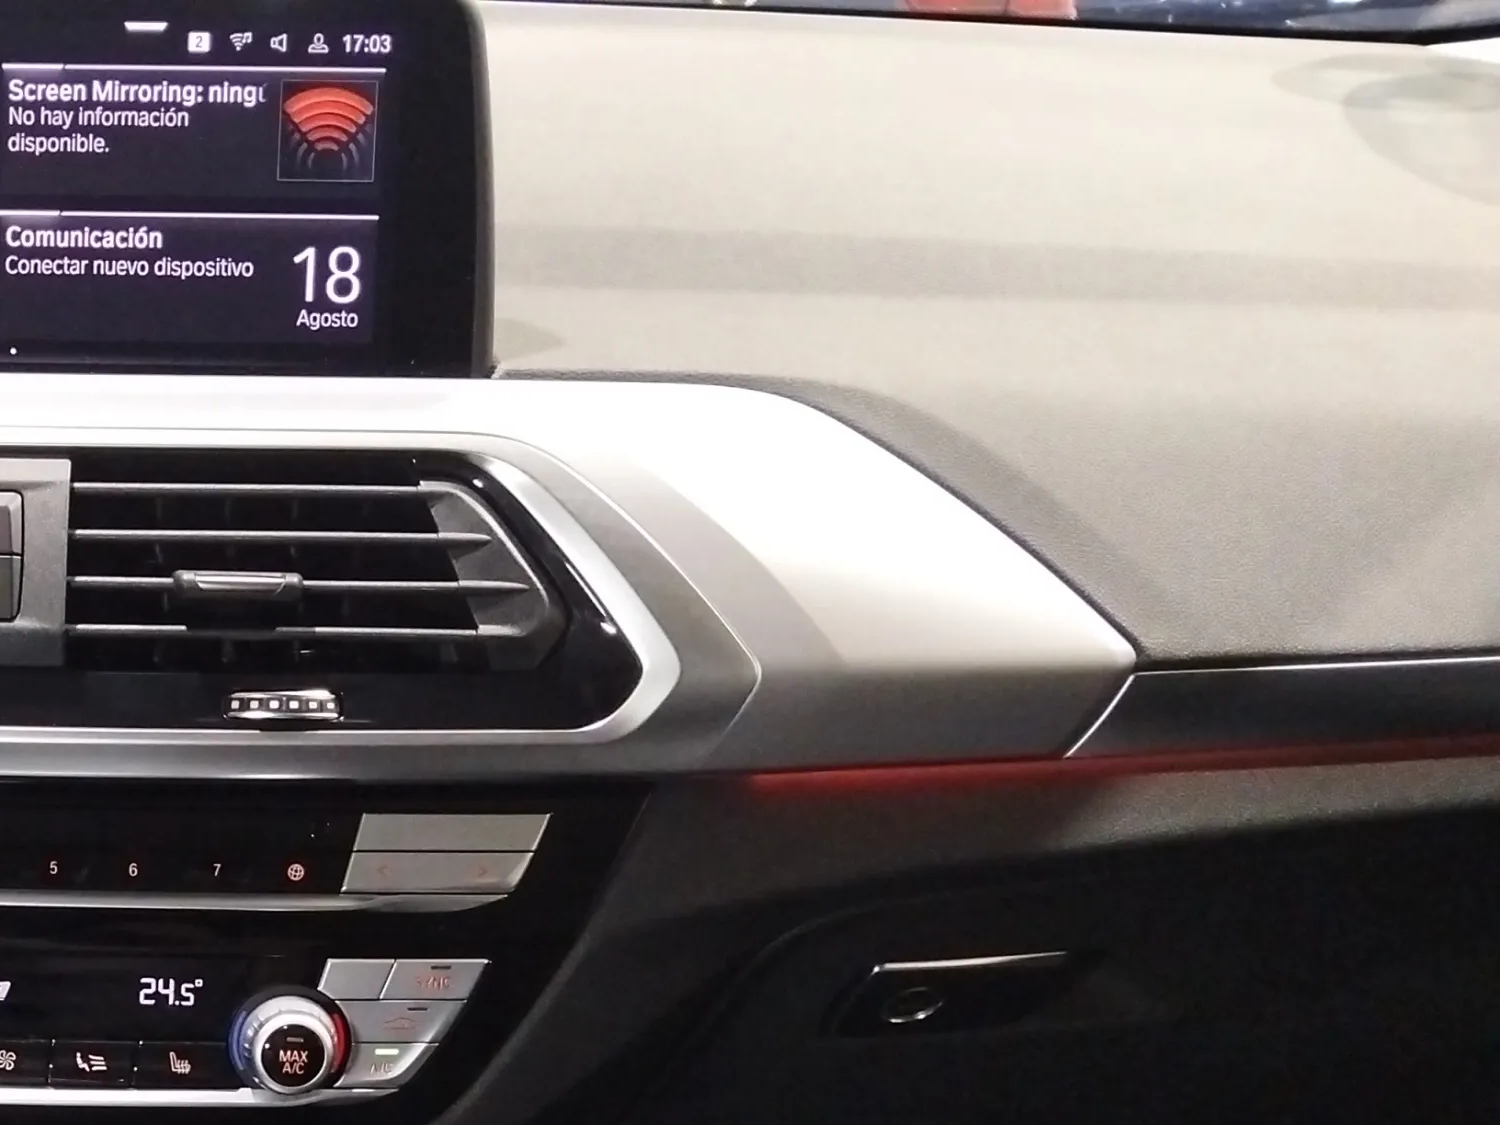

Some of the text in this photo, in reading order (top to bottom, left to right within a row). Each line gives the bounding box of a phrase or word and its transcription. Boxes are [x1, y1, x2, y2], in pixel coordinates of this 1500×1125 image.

[342, 34, 392, 53] 17:03
[8, 79, 86, 102] Screen
[92, 80, 204, 107] Mirroring:
[8, 106, 189, 130] No hay información
[7, 132, 110, 155] disponible.
[4, 226, 163, 249] Comunicación
[4, 255, 254, 280] Conectar nuevo dispositivo
[293, 245, 361, 304] 18
[296, 309, 359, 330] Agosto
[49, 861, 58, 876] 5
[128, 863, 138, 878] 6
[212, 863, 222, 878] 7
[278, 1050, 309, 1063] MAX
[282, 1062, 305, 1075] A/C
